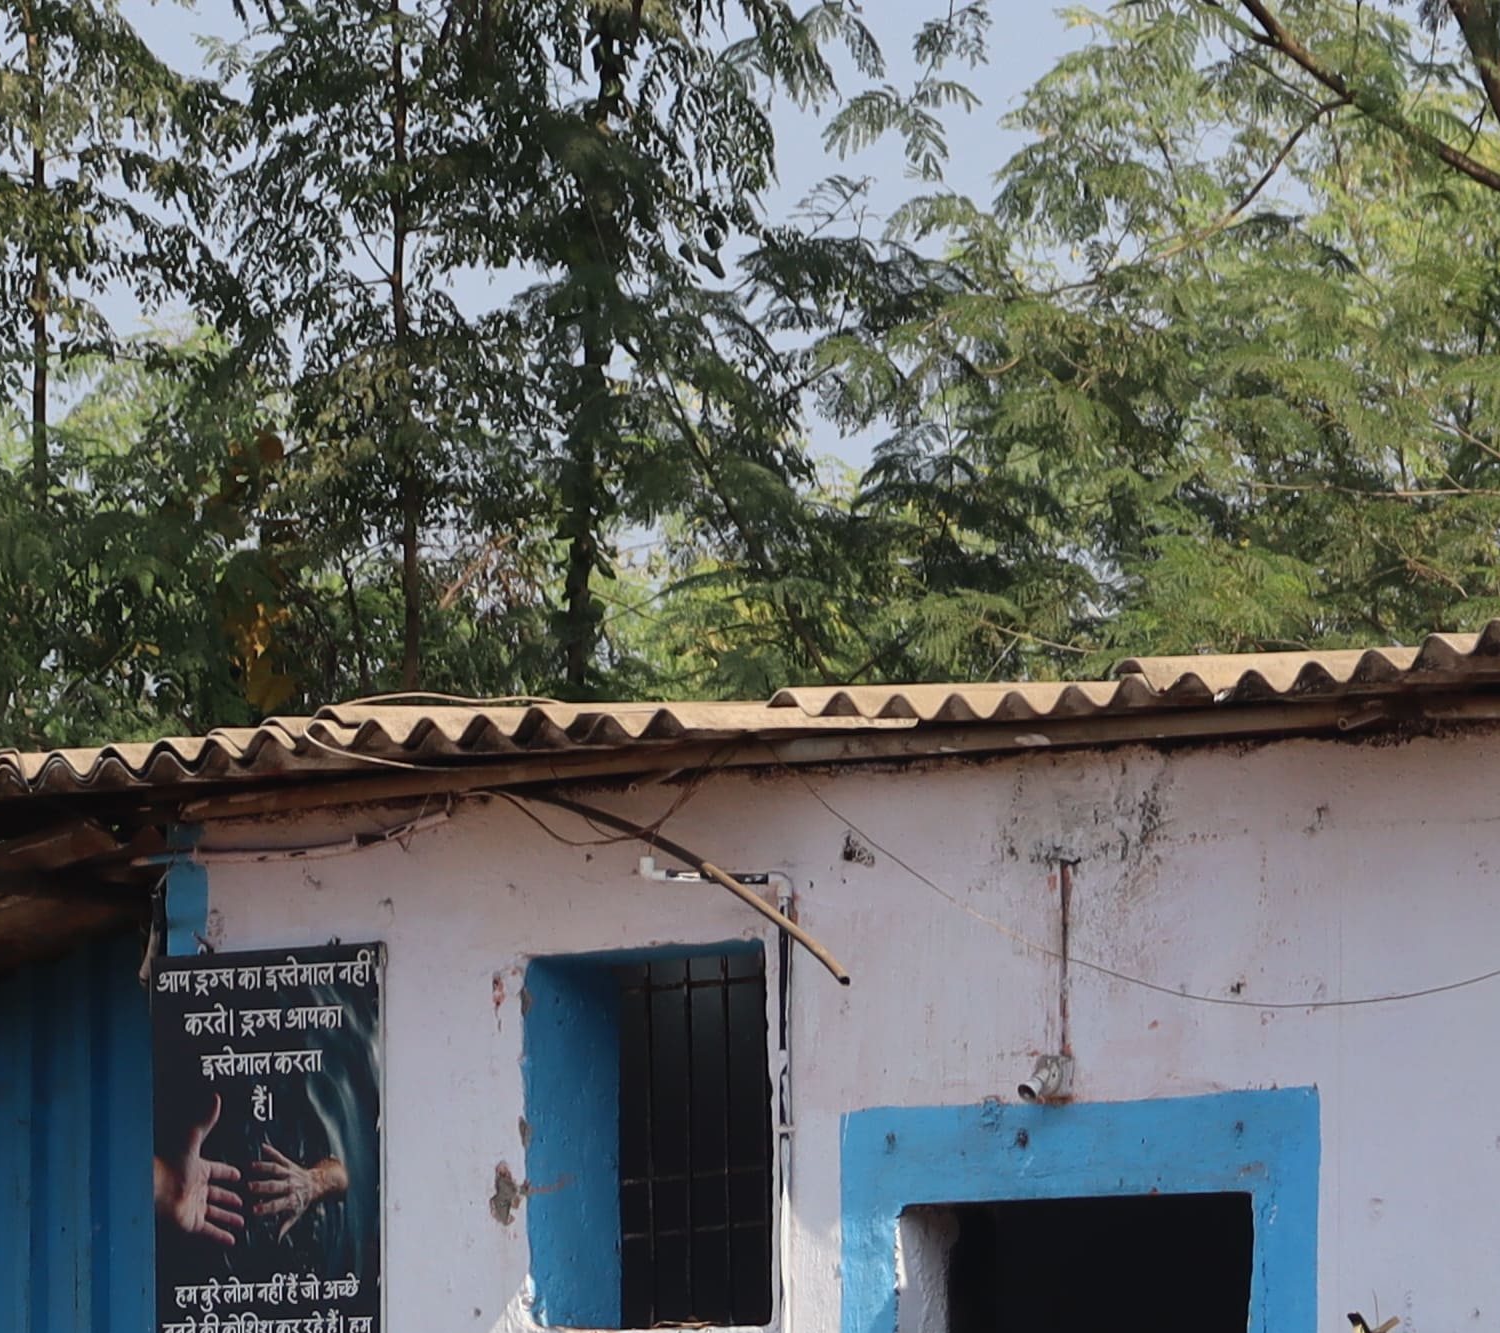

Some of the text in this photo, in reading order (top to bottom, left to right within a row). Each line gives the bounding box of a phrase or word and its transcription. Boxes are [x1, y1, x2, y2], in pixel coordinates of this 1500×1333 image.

[156, 950, 375, 996] आप ड्रग्स का इस्तेमाल नहीं
[184, 1003, 343, 1037] करते। ड्रग्स आपका
[201, 1046, 323, 1080] इस्तेमाल करता
